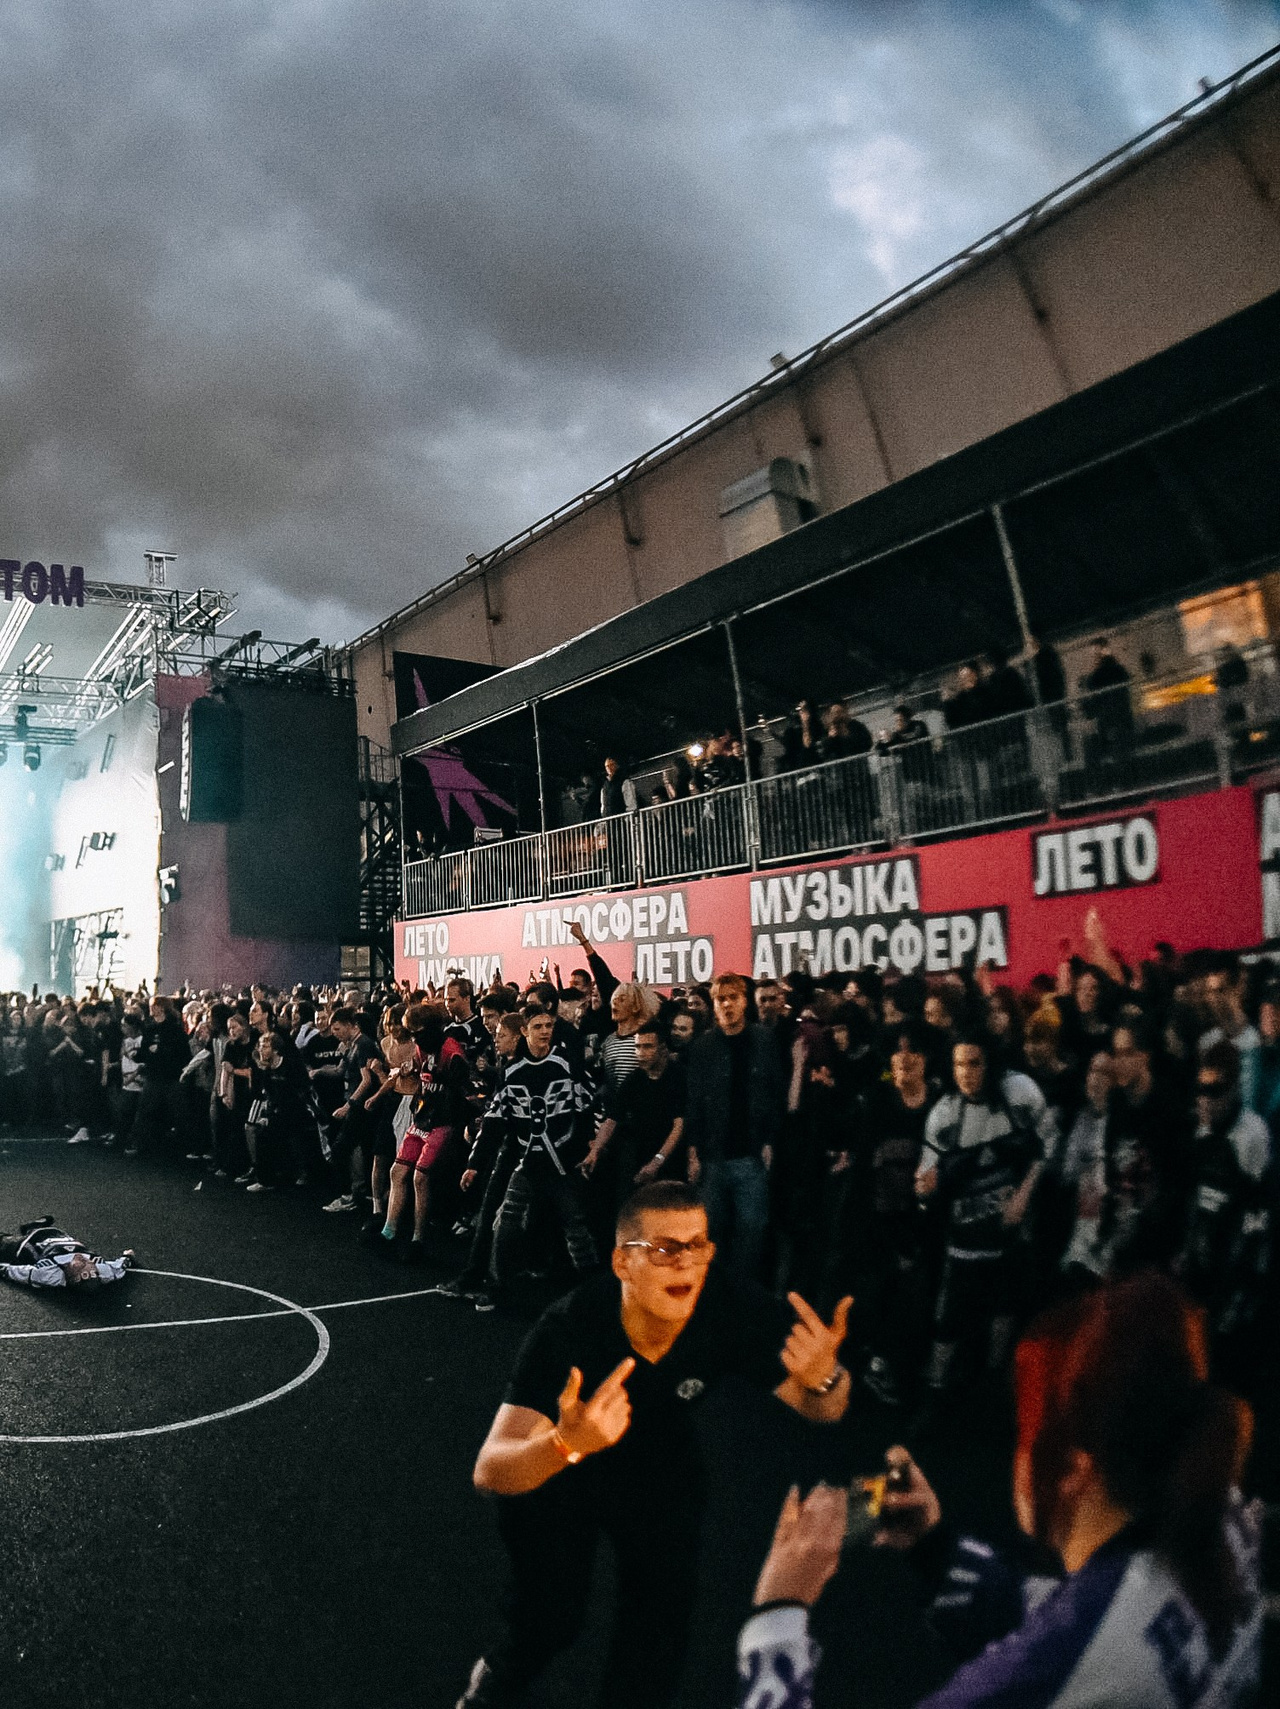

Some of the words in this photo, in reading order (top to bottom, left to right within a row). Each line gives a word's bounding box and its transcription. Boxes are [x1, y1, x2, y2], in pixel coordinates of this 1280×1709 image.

[1034, 817, 1158, 895] ЛЕТО
[522, 892, 689, 948] АТМОСФЕРА
[750, 859, 919, 926] МУЗЫКА
[403, 921, 449, 957] ЛЕТО
[637, 938, 714, 984] ЛЕТО
[752, 911, 1008, 980] АТМОСФЕРА
